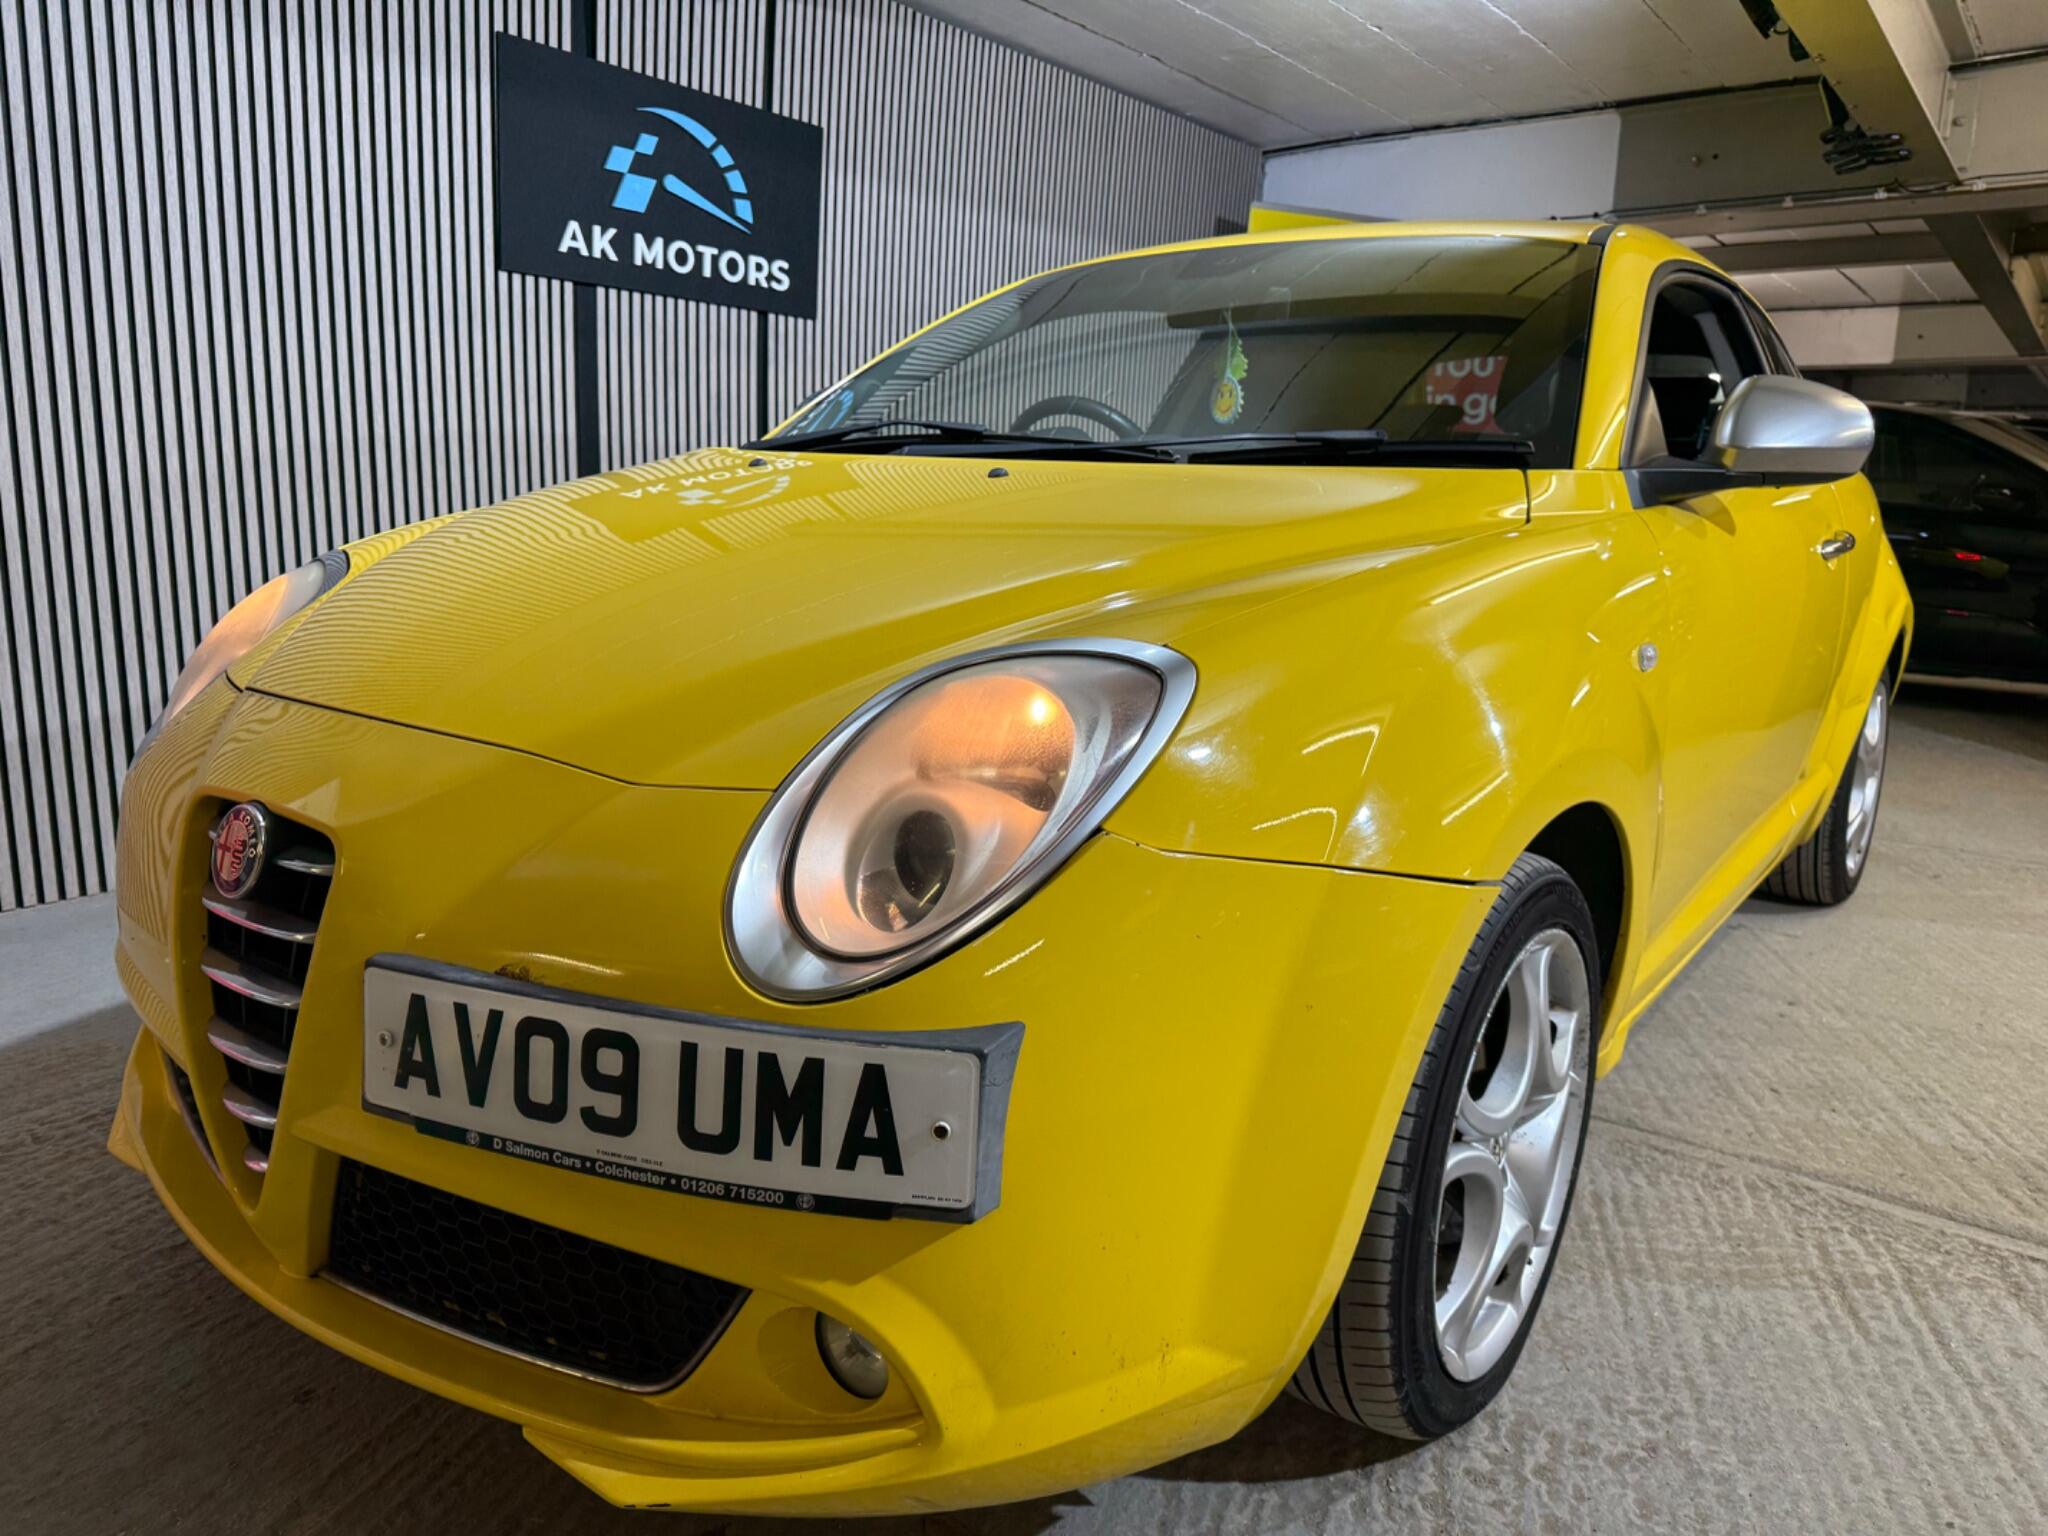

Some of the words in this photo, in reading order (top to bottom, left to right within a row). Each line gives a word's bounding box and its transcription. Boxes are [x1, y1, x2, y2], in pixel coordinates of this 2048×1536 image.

[557, 219, 619, 263] AK
[633, 232, 791, 292] MOTORS
[394, 993, 641, 1139] AV09
[676, 1040, 905, 1177] UMA
[493, 1137, 503, 1150] D
[505, 1140, 550, 1162] Salmon
[553, 1151, 582, 1168] Cars
[594, 1160, 667, 1186] Colchester
[681, 1178, 725, 1196] 01206
[729, 1186, 784, 1204] 715200
